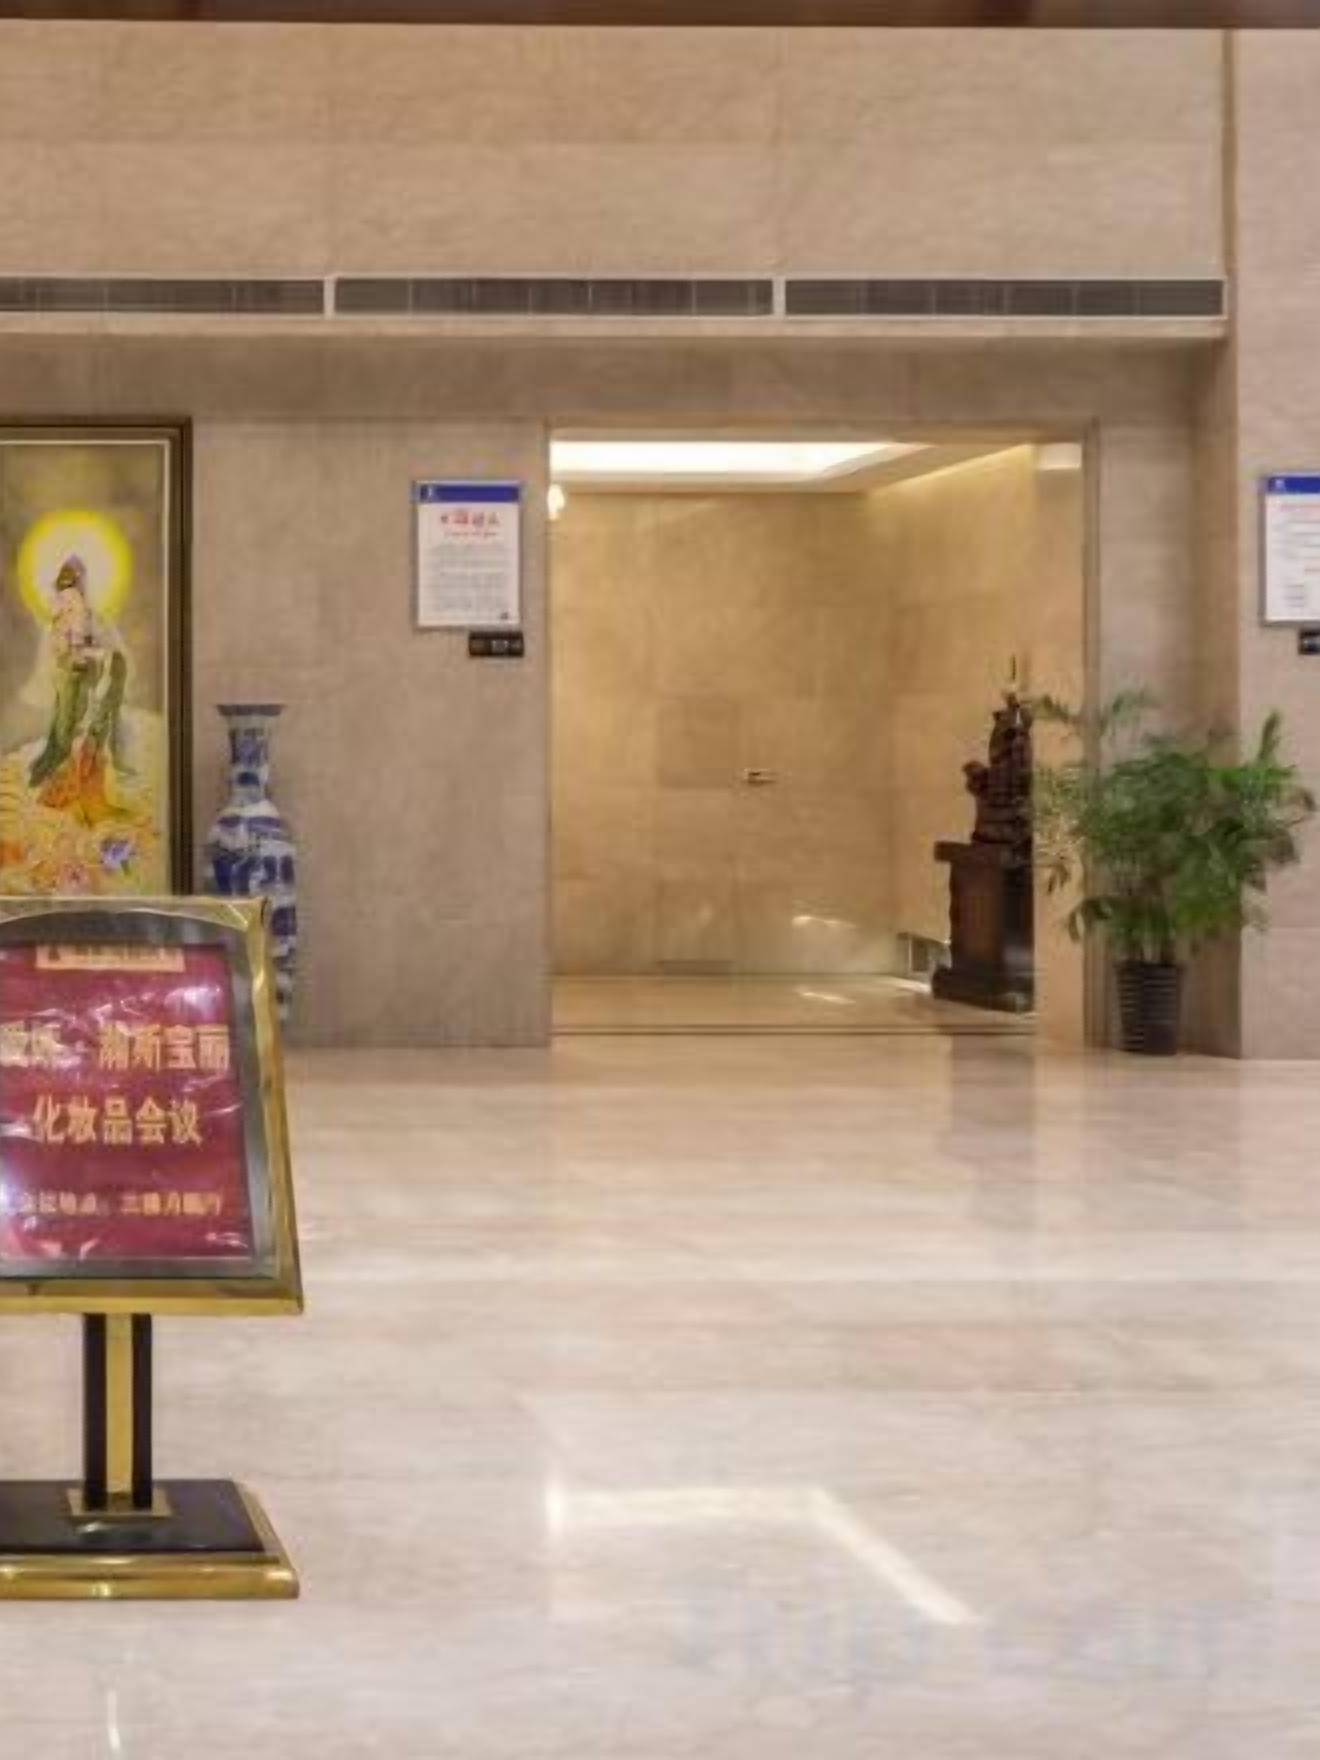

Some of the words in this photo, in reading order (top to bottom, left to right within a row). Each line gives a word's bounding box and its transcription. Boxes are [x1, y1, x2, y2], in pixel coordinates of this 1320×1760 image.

[32, 1095, 204, 1147] 化妆品会议
